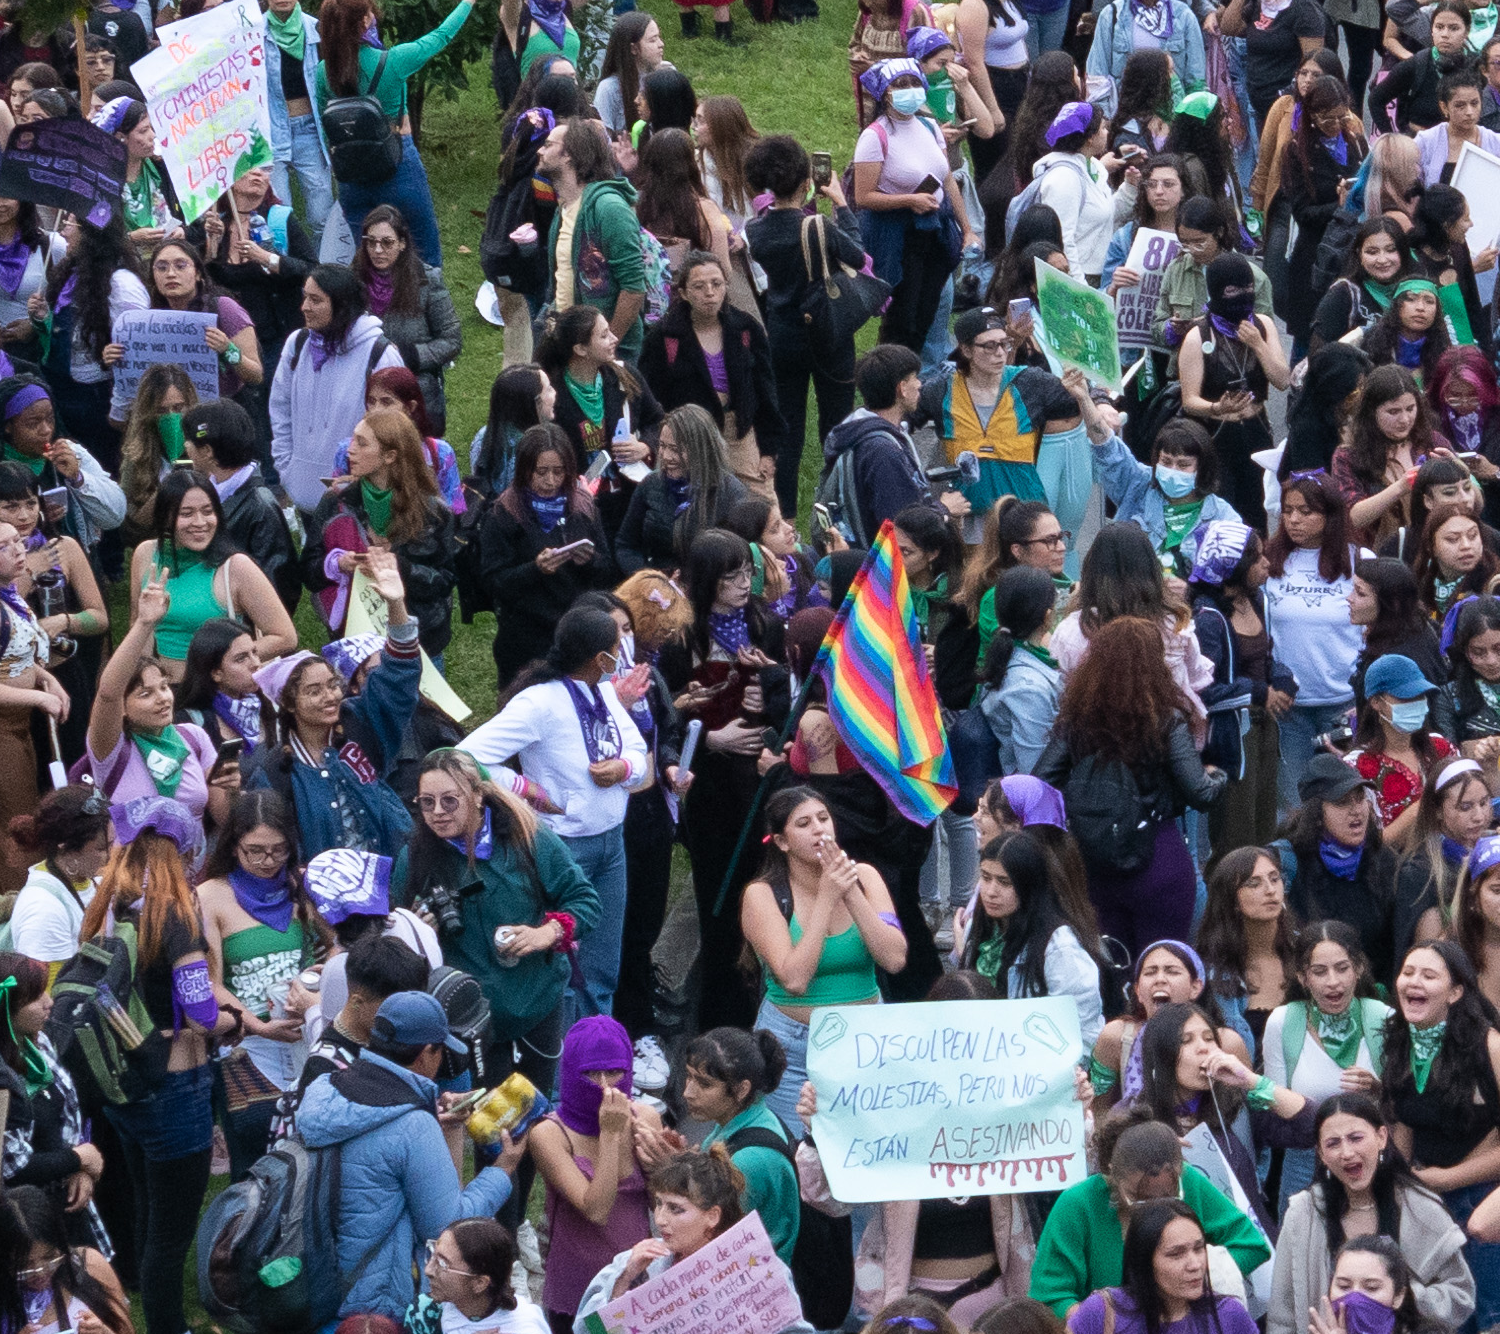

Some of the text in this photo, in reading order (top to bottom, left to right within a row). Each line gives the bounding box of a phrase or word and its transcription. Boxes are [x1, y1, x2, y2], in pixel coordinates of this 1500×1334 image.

[154, 51, 248, 124] FEMINISTAS
[186, 131, 248, 190] LIBRES
[854, 1027, 1026, 1070] DISCULPEN LAS
[828, 1072, 1050, 1117] MOLESTIAS, PERO NOS
[842, 1117, 1072, 1170] ESTÁN ASESINANDO
[730, 1233, 756, 1255] cada
